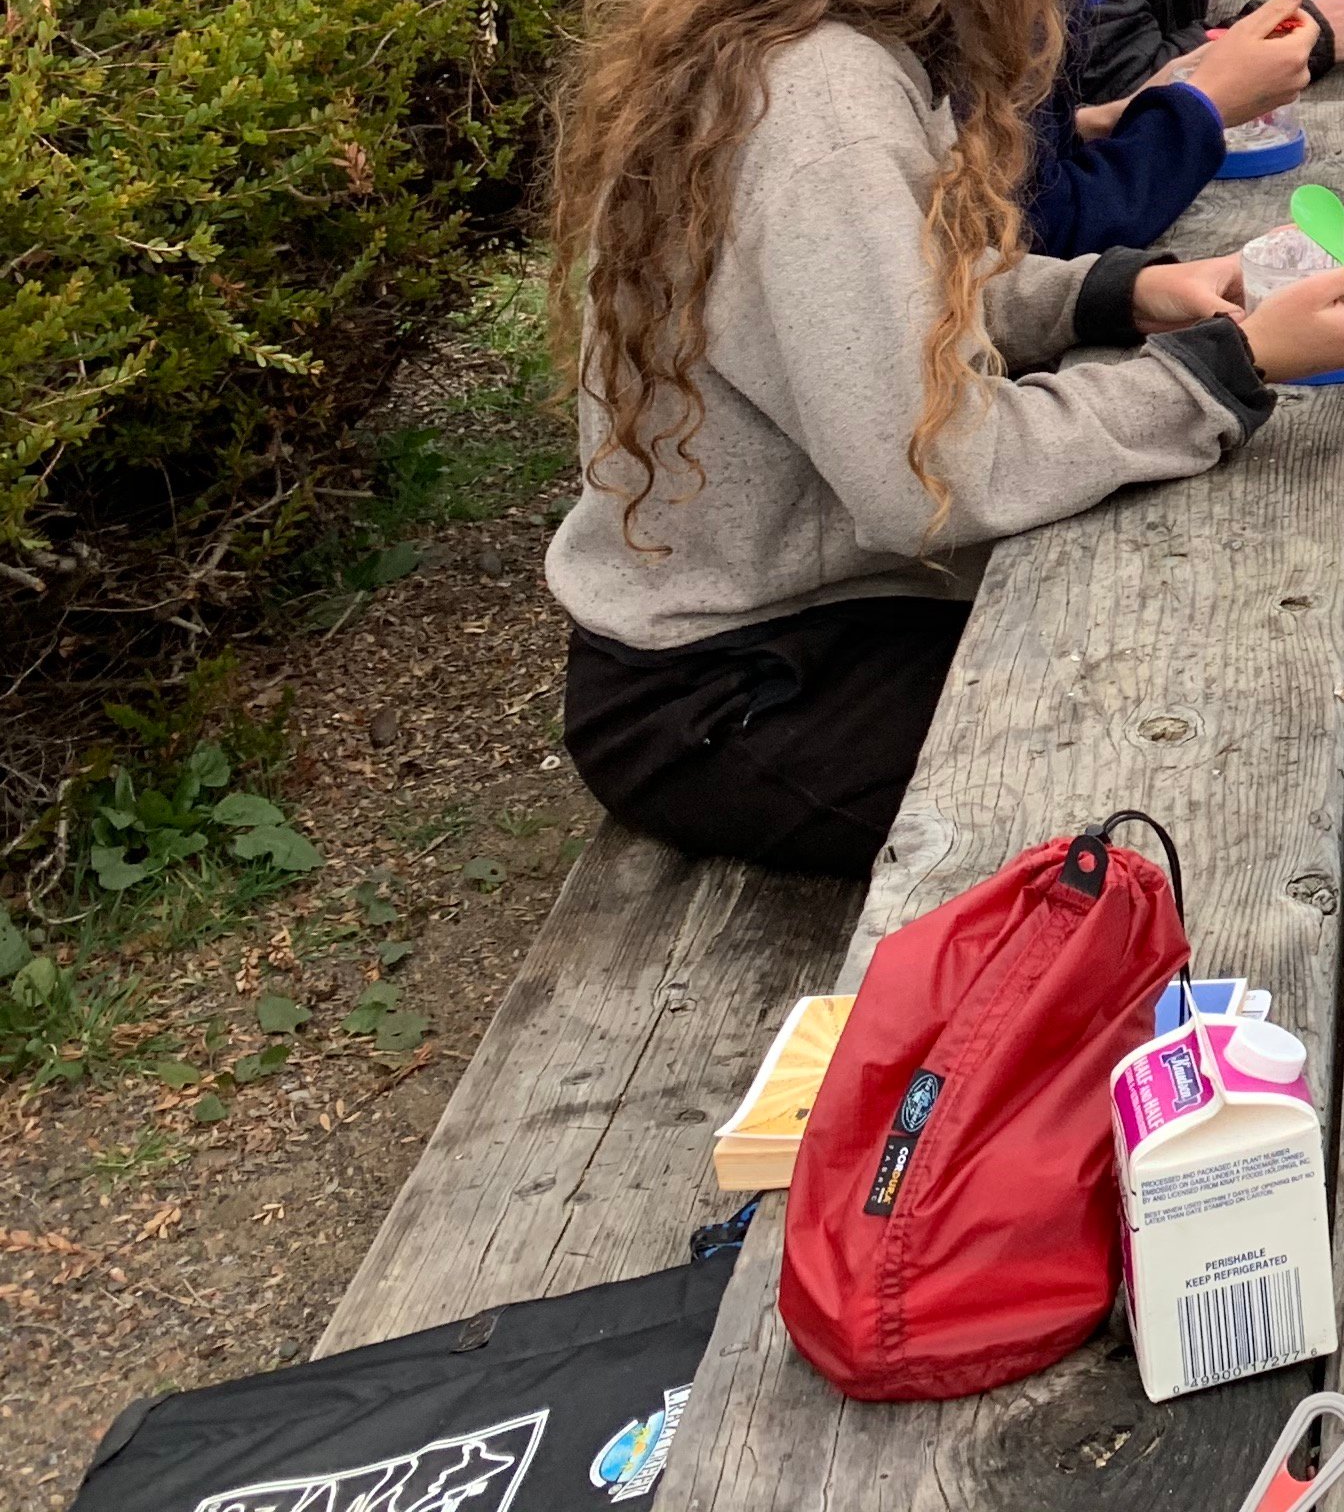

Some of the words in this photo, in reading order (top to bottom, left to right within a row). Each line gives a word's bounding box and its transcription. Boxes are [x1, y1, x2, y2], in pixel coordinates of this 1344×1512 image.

[1132, 1055, 1153, 1086] HALF
[1143, 1097, 1165, 1129] HALF
[1171, 1054, 1192, 1098] Knudsen
[871, 1144, 894, 1202] FABRIC
[882, 1146, 909, 1205] CORDURA
[1185, 1274, 1212, 1289] KEEP
[1214, 1254, 1288, 1282] REFRIGERATED
[1205, 1248, 1266, 1272] PERISHABLE
[1173, 1385, 1180, 1394] 0
[1190, 1368, 1242, 1387] 49900
[1252, 1350, 1300, 1372] 17277
[1311, 1347, 1318, 1357] 6
